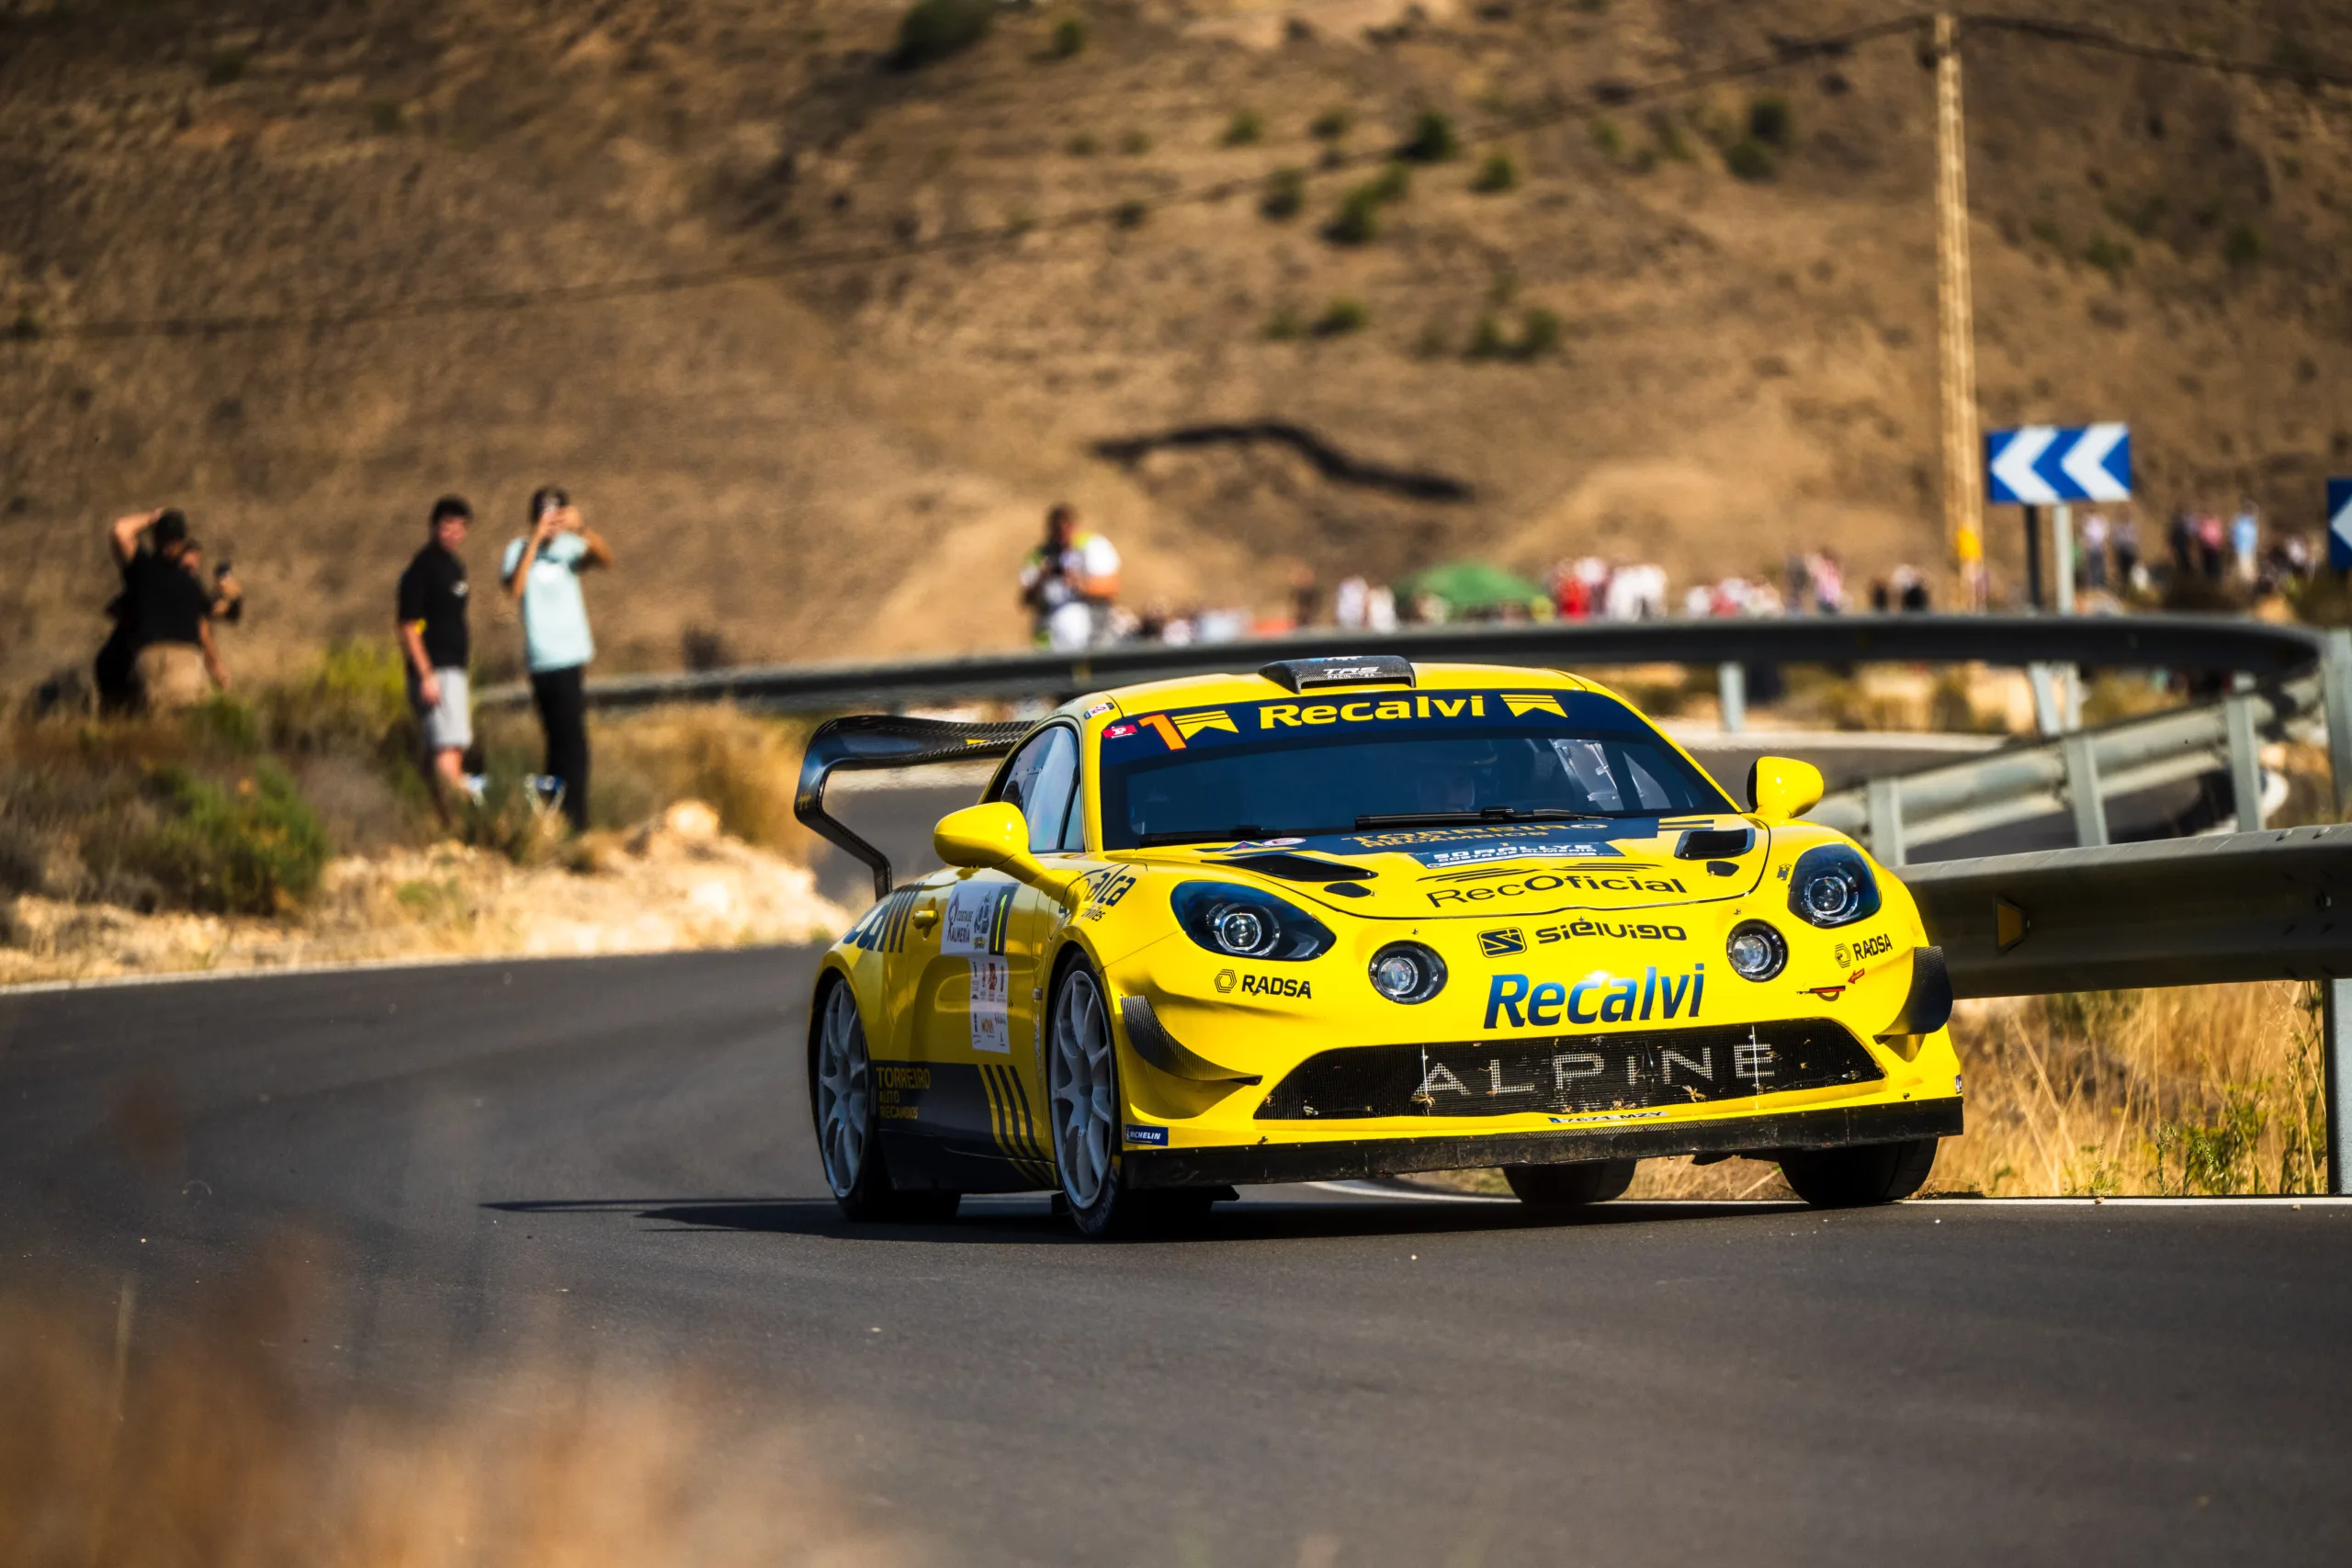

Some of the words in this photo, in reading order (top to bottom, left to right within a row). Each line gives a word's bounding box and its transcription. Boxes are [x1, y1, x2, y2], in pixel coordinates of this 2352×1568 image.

[1259, 695, 1486, 729] Recalvi
[1426, 875, 1688, 908] RecOficial
[1852, 933, 1894, 962] RADSA
[1241, 975, 1312, 999] RADSA
[1483, 963, 1705, 1029] Recalvi
[876, 1066, 931, 1089] TORREIRO
[1412, 1043, 1775, 1096] ALPINE
